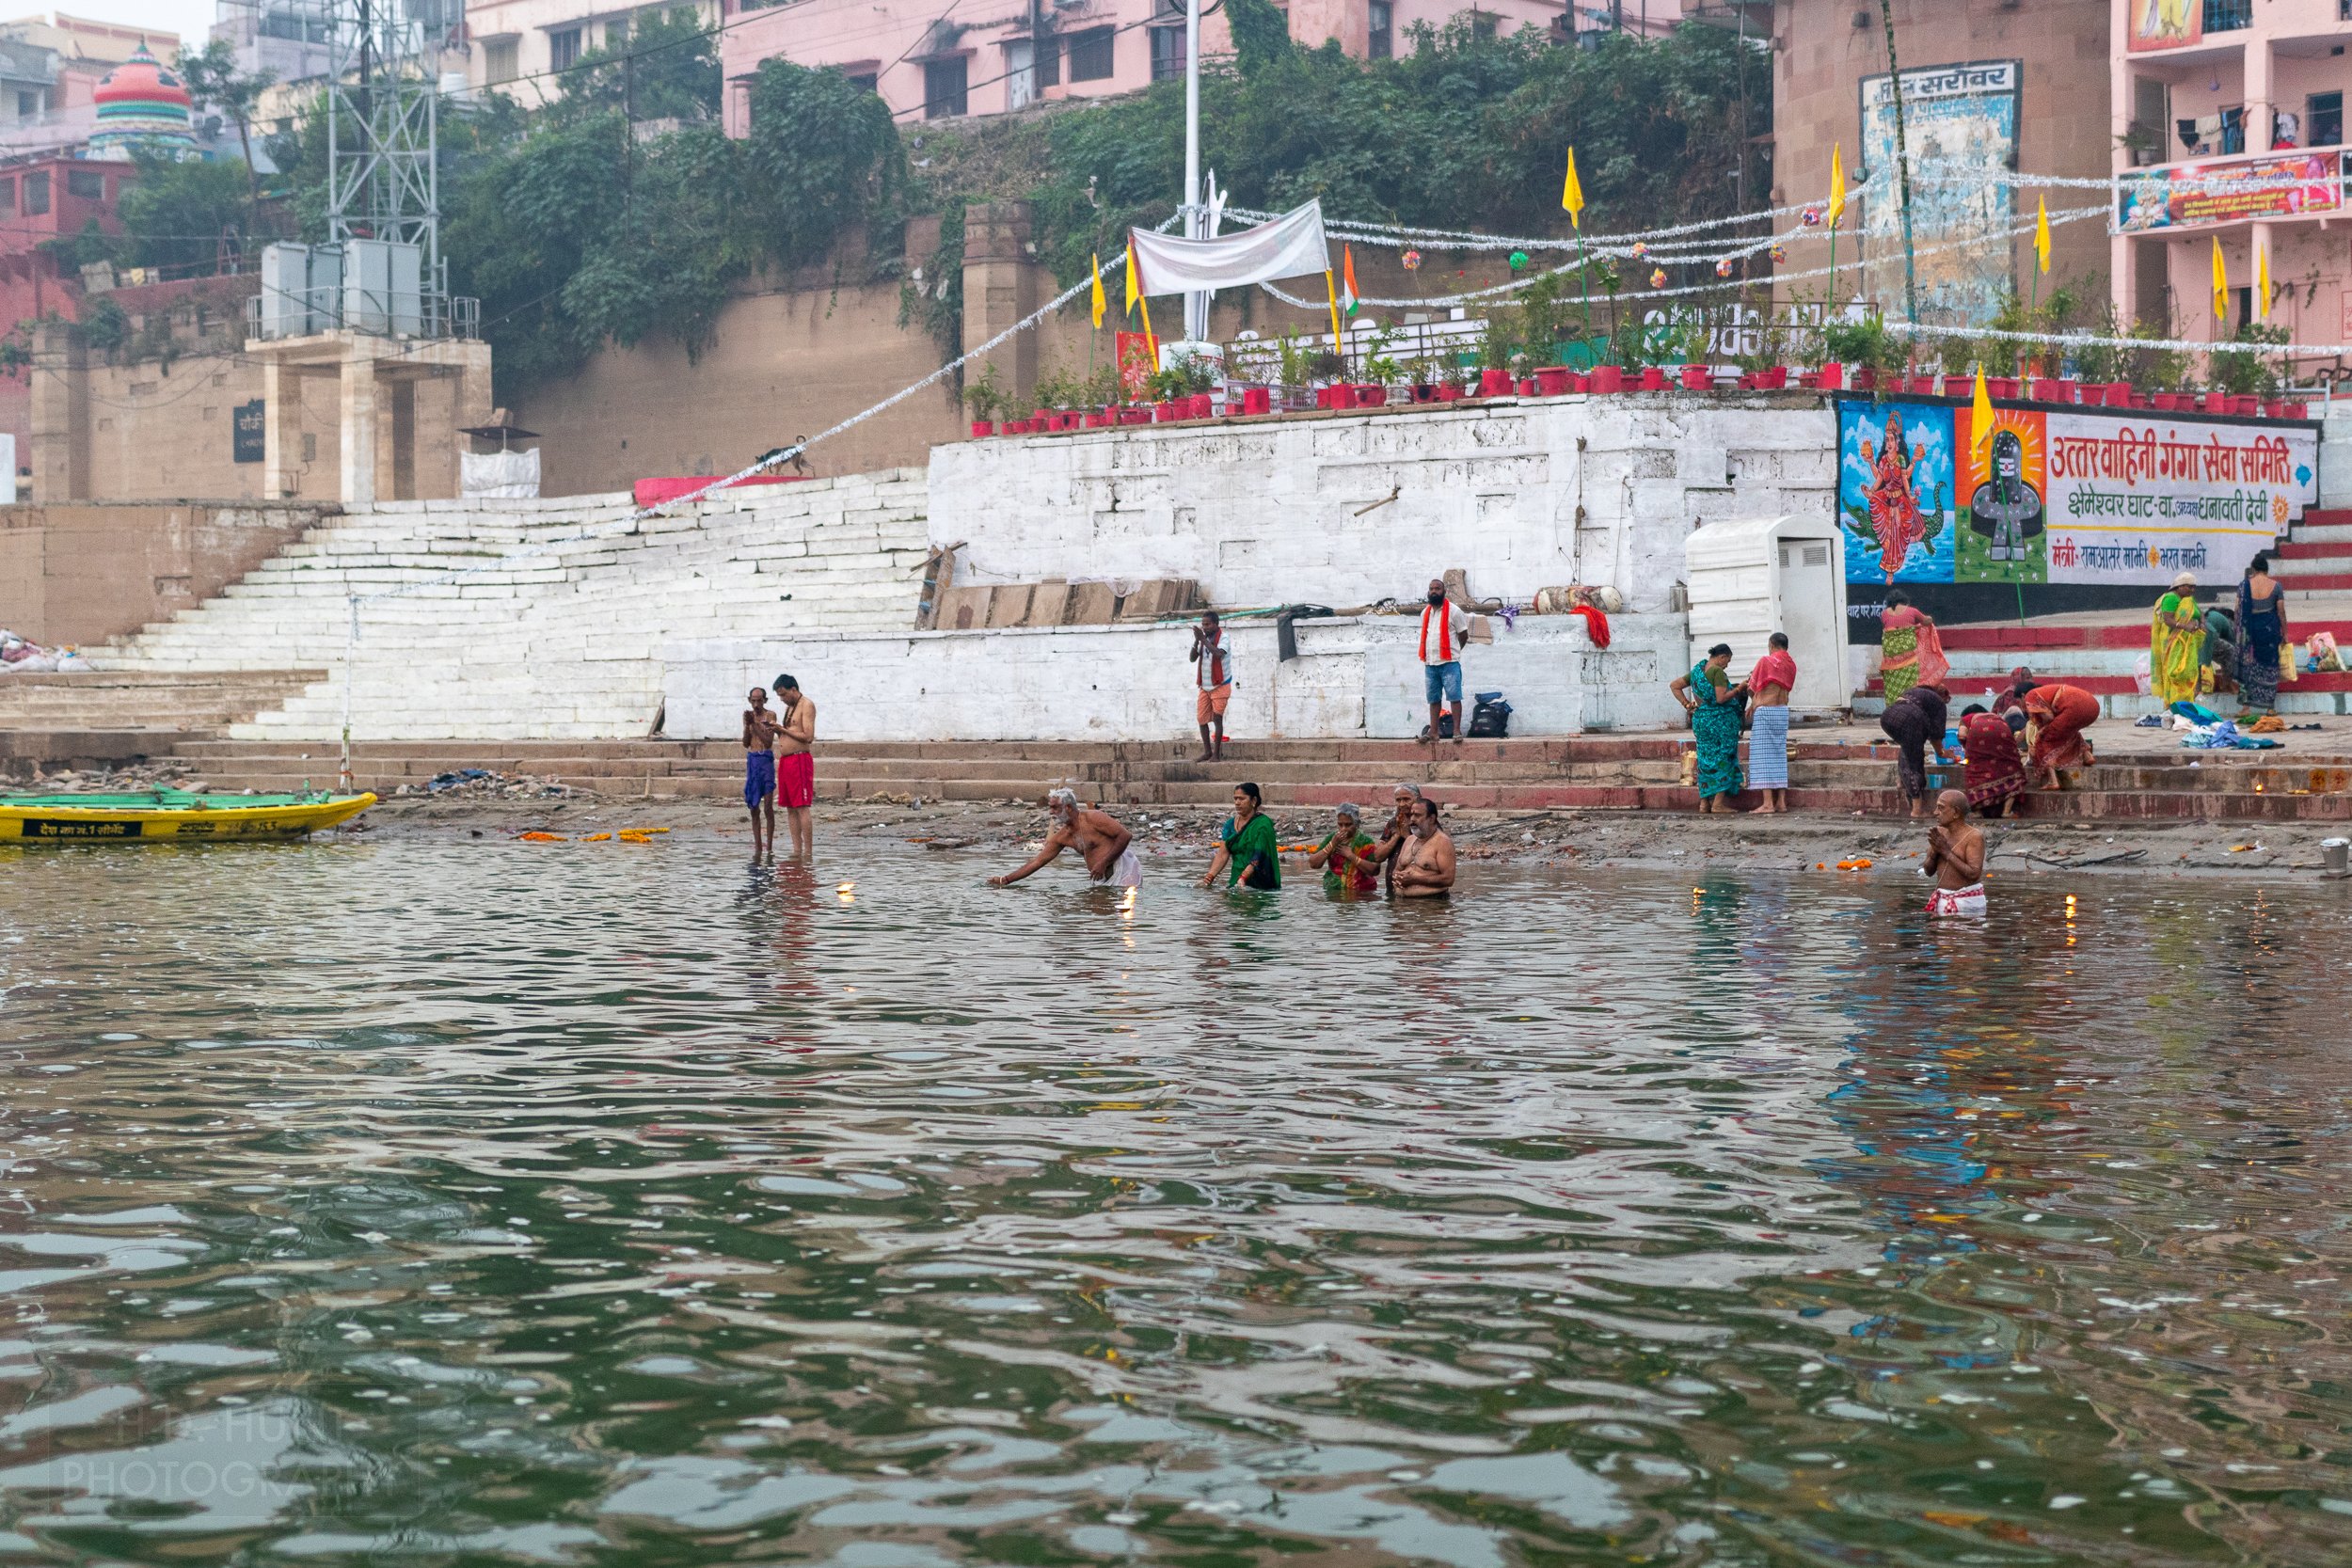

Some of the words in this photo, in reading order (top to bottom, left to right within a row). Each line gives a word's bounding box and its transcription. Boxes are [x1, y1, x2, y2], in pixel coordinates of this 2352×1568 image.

[2050, 436, 2099, 480] उत्तर
[2100, 426, 2156, 486] वाहिनी
[2159, 429, 2201, 482] गंगा
[2203, 433, 2238, 483] सेवा
[2240, 435, 2292, 484] समिति
[2199, 488, 2244, 523] धनावती
[2246, 489, 2268, 525] देवी
[2160, 546, 2180, 571] भरत
